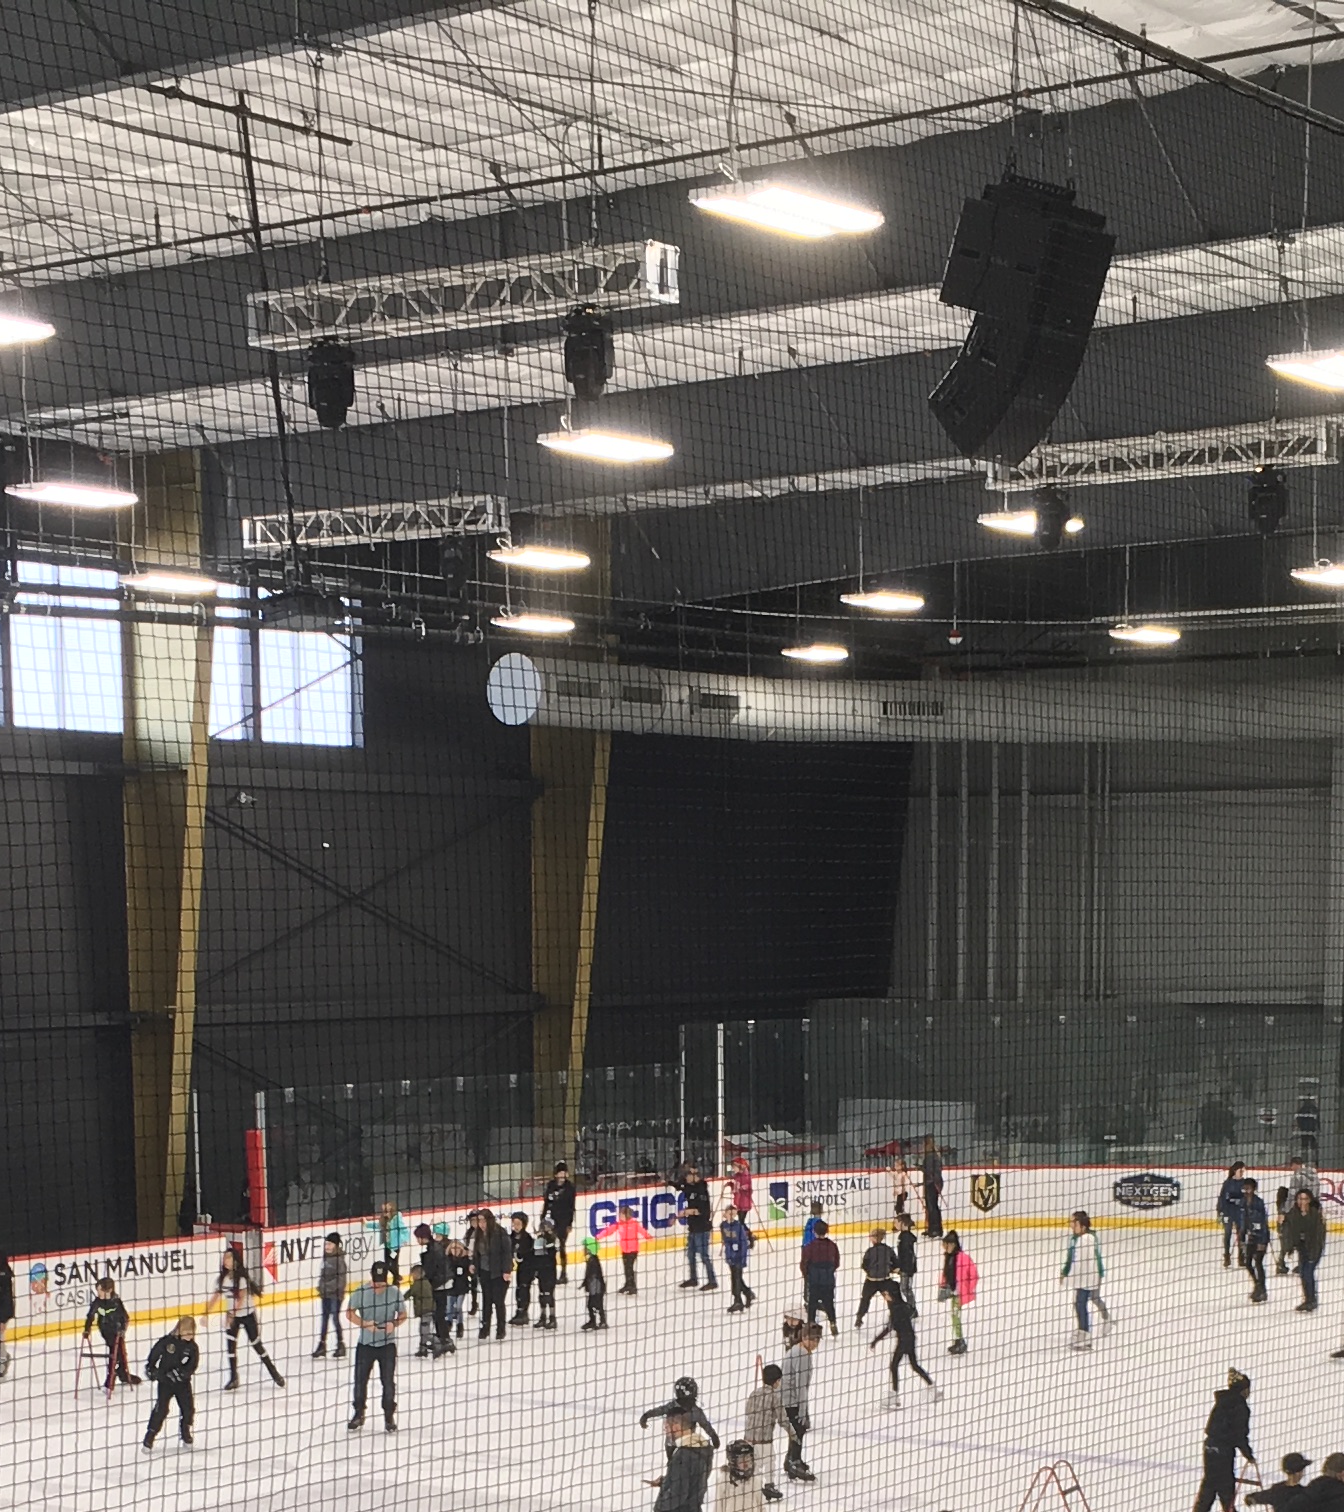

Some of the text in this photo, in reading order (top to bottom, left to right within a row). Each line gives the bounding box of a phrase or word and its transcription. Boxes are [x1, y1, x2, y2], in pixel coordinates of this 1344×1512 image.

[795, 1177, 871, 1194] SILVER STATE
[1115, 1186, 1178, 1197] NEXTGEN
[280, 1234, 374, 1264] NVErgy
[54, 1248, 195, 1286] SAN MANUEL
